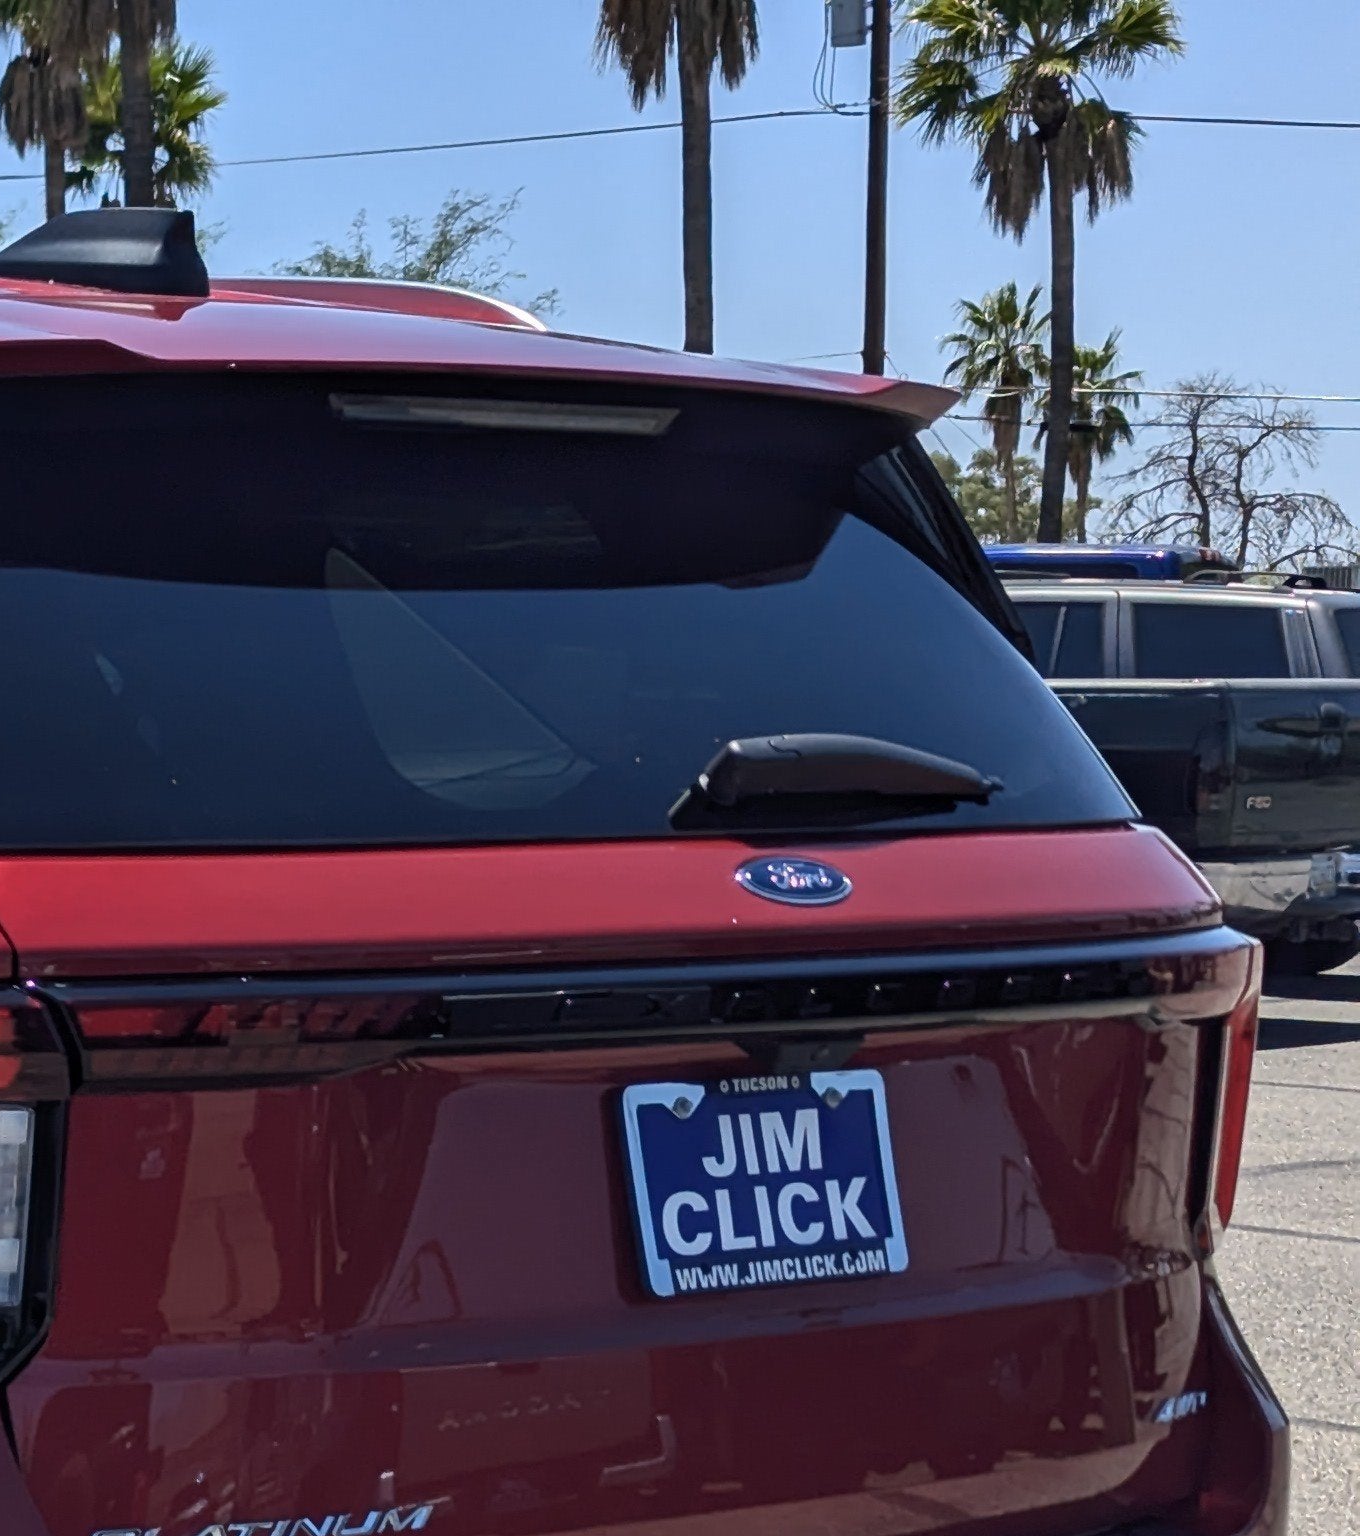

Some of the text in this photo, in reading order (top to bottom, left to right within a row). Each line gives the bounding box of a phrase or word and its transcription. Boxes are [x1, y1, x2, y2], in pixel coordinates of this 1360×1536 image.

[732, 1075, 789, 1093] TUCSON
[702, 1107, 823, 1178] JIM
[662, 1176, 877, 1256] CLICK
